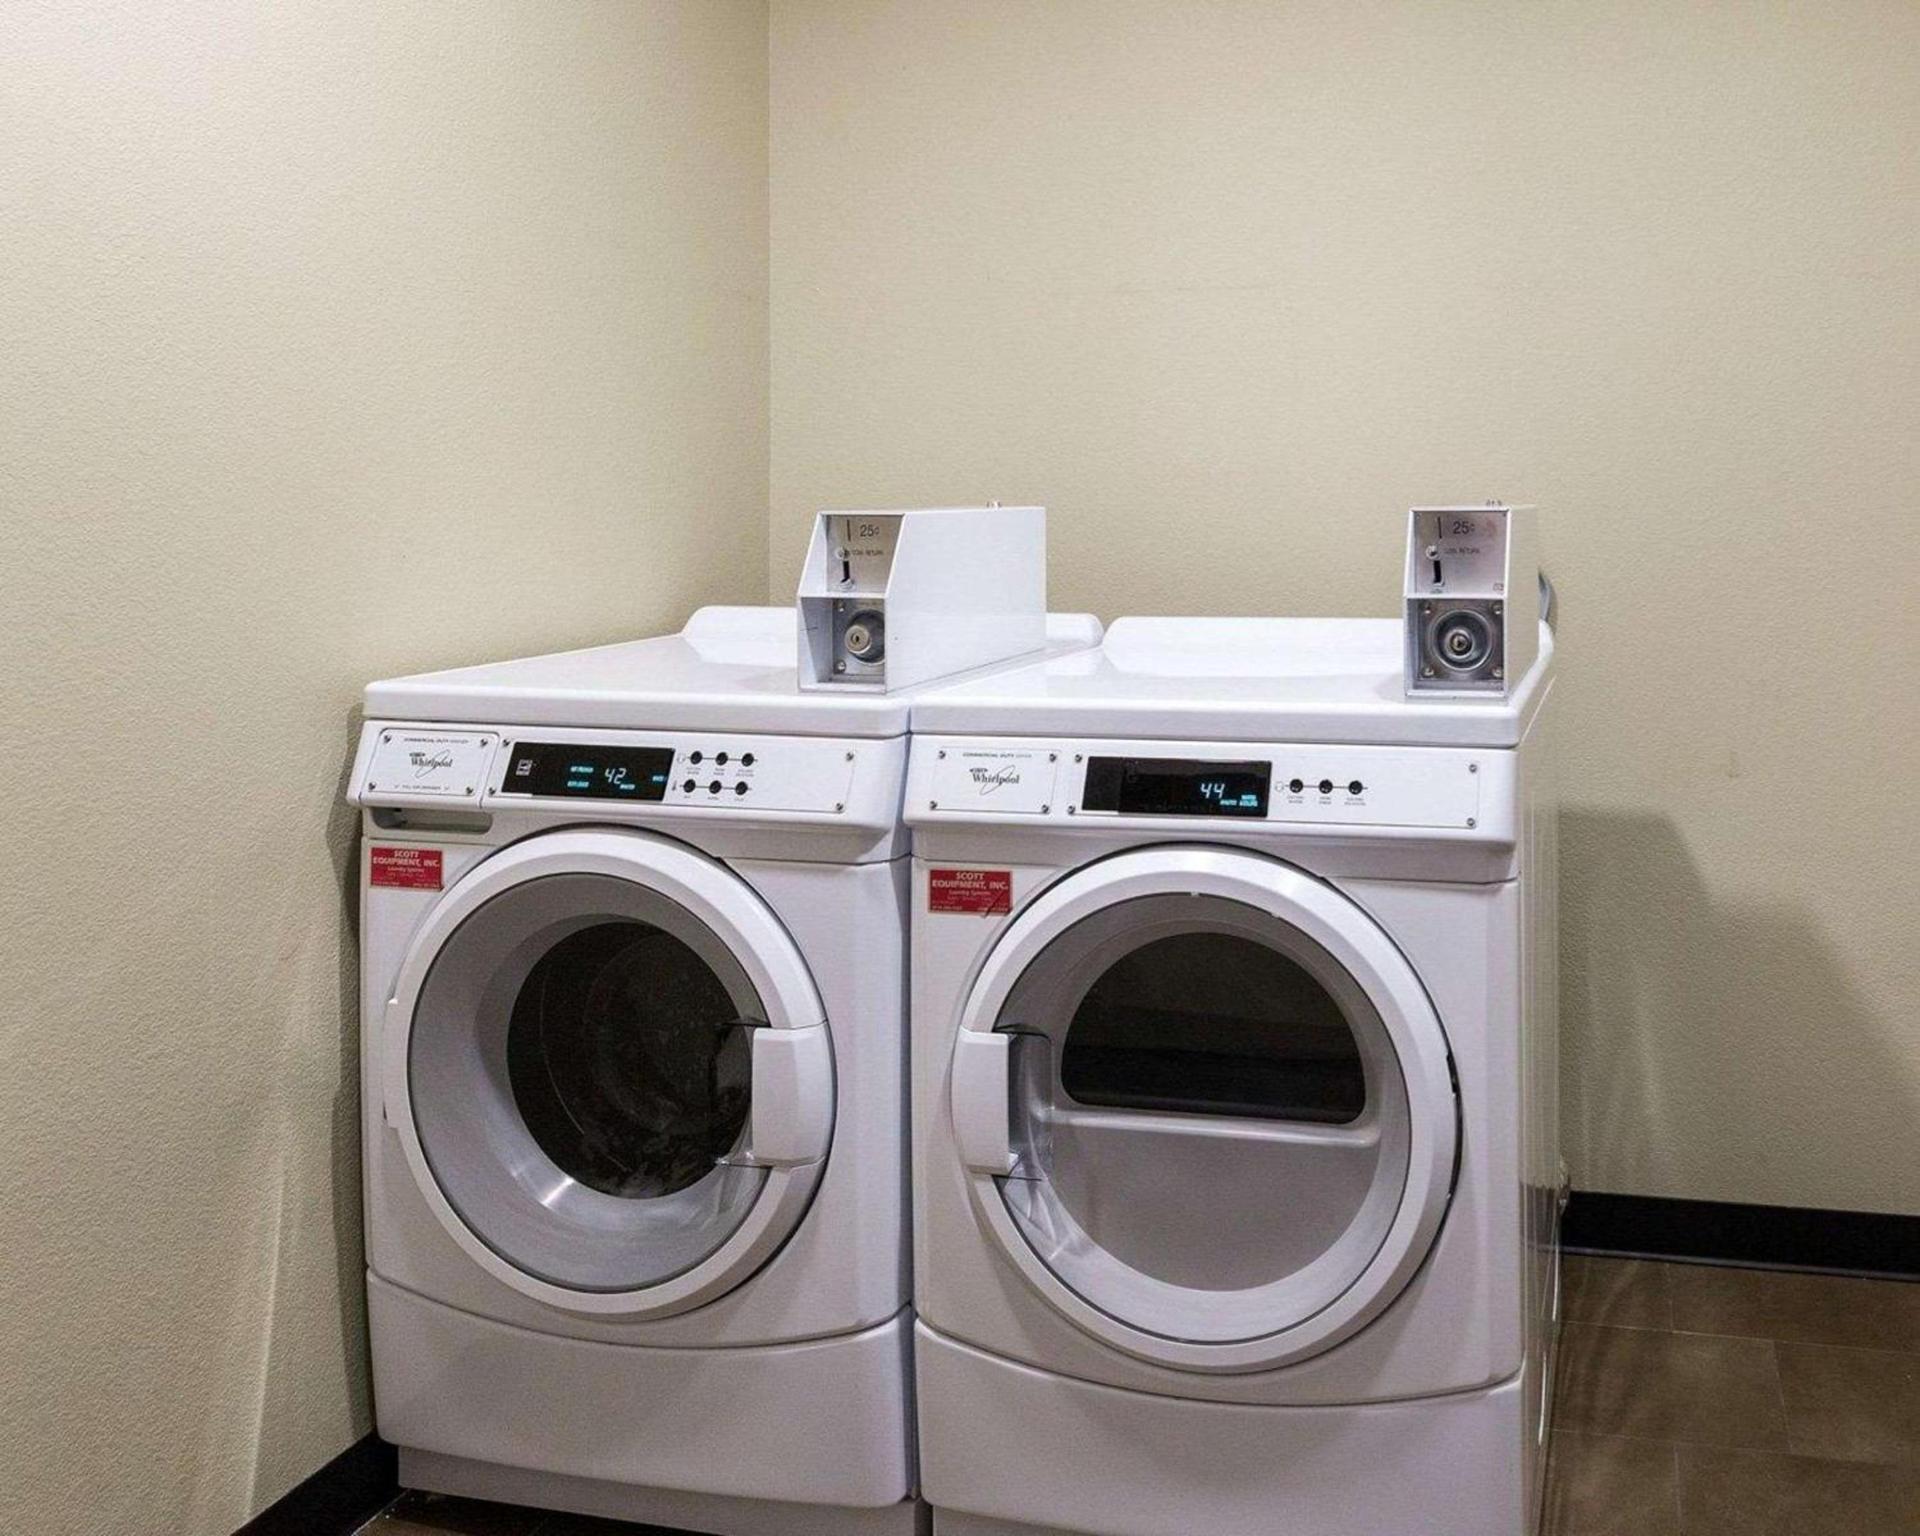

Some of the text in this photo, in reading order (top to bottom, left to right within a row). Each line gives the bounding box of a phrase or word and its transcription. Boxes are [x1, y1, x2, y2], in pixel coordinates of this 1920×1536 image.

[410, 757, 454, 770] Whirlpool
[604, 767, 627, 785] 42
[971, 772, 1020, 787] Whirlpool
[1200, 783, 1225, 799] 44
[393, 850, 420, 858] SCOTT
[423, 859, 440, 868] INC.
[955, 871, 985, 880] SCOTT
[931, 879, 1009, 890] EQUIPMENT, INC.
